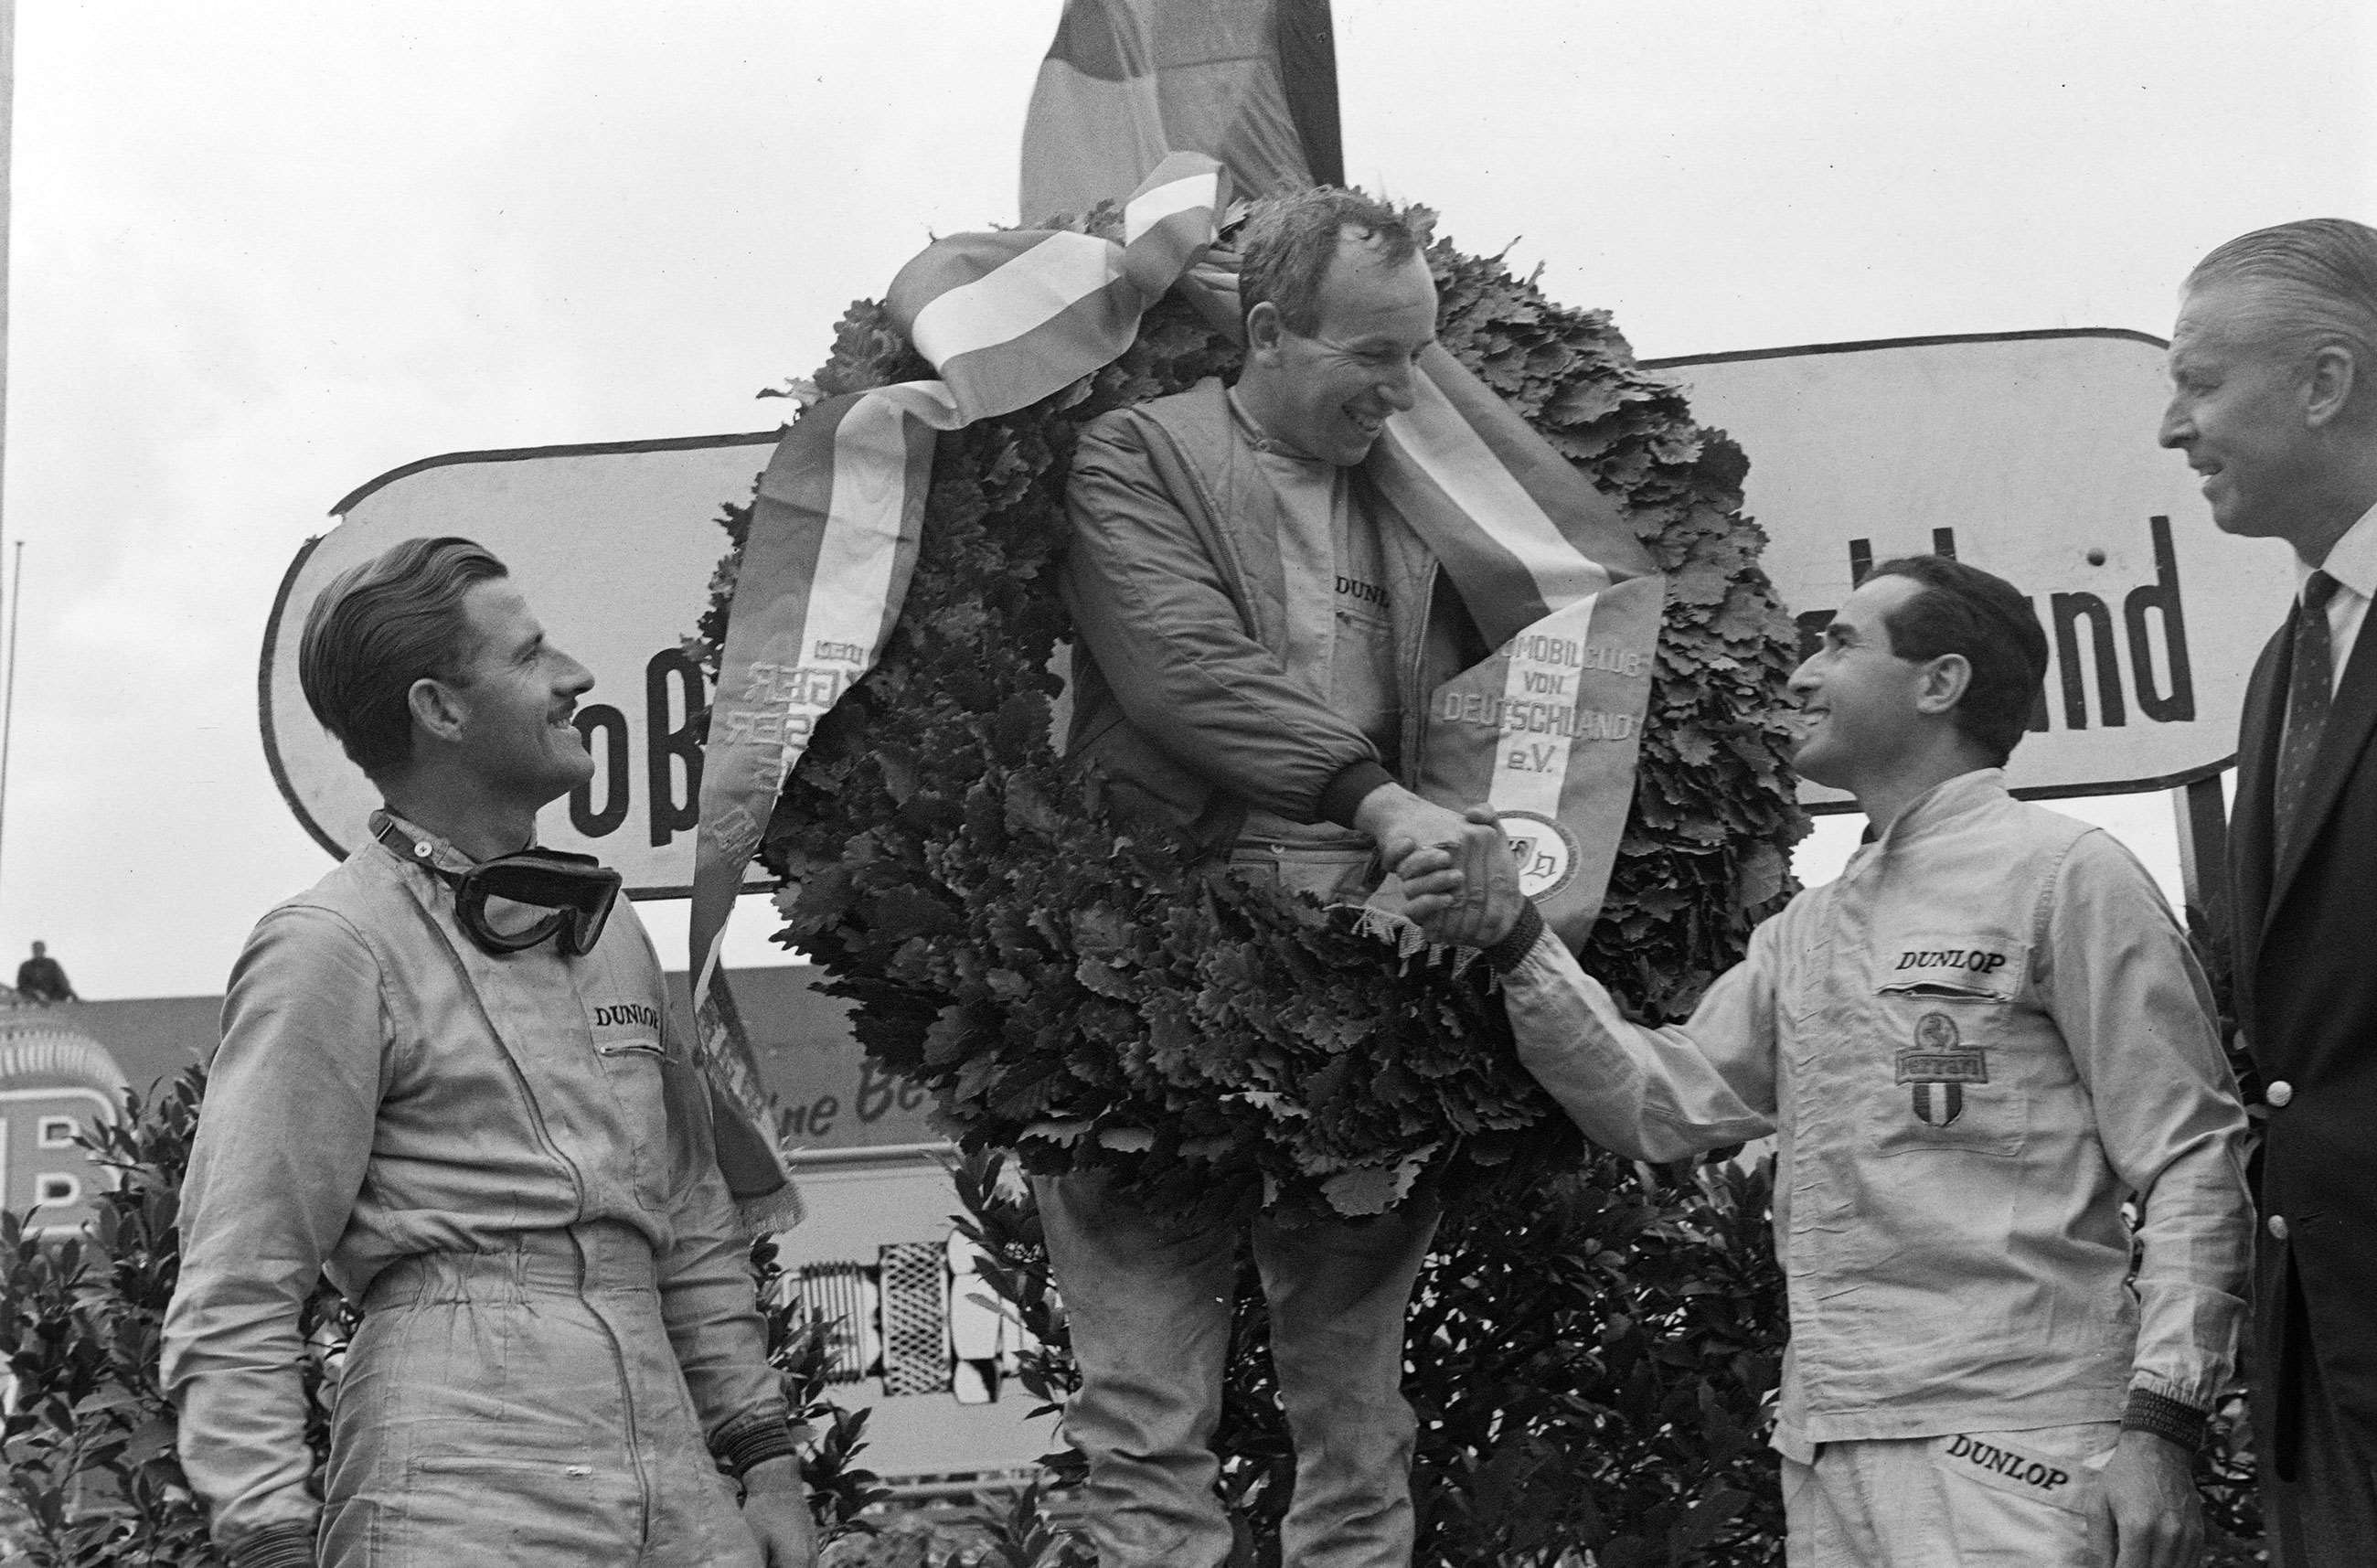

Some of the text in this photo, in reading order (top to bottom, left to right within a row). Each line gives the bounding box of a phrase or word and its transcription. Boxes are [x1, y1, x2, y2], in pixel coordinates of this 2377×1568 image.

[1335, 575, 1390, 609] DUNL
[1523, 670, 1565, 695] VON
[1894, 950, 2007, 974] DUNLOP
[1945, 1434, 2070, 1491] DUNLOP
